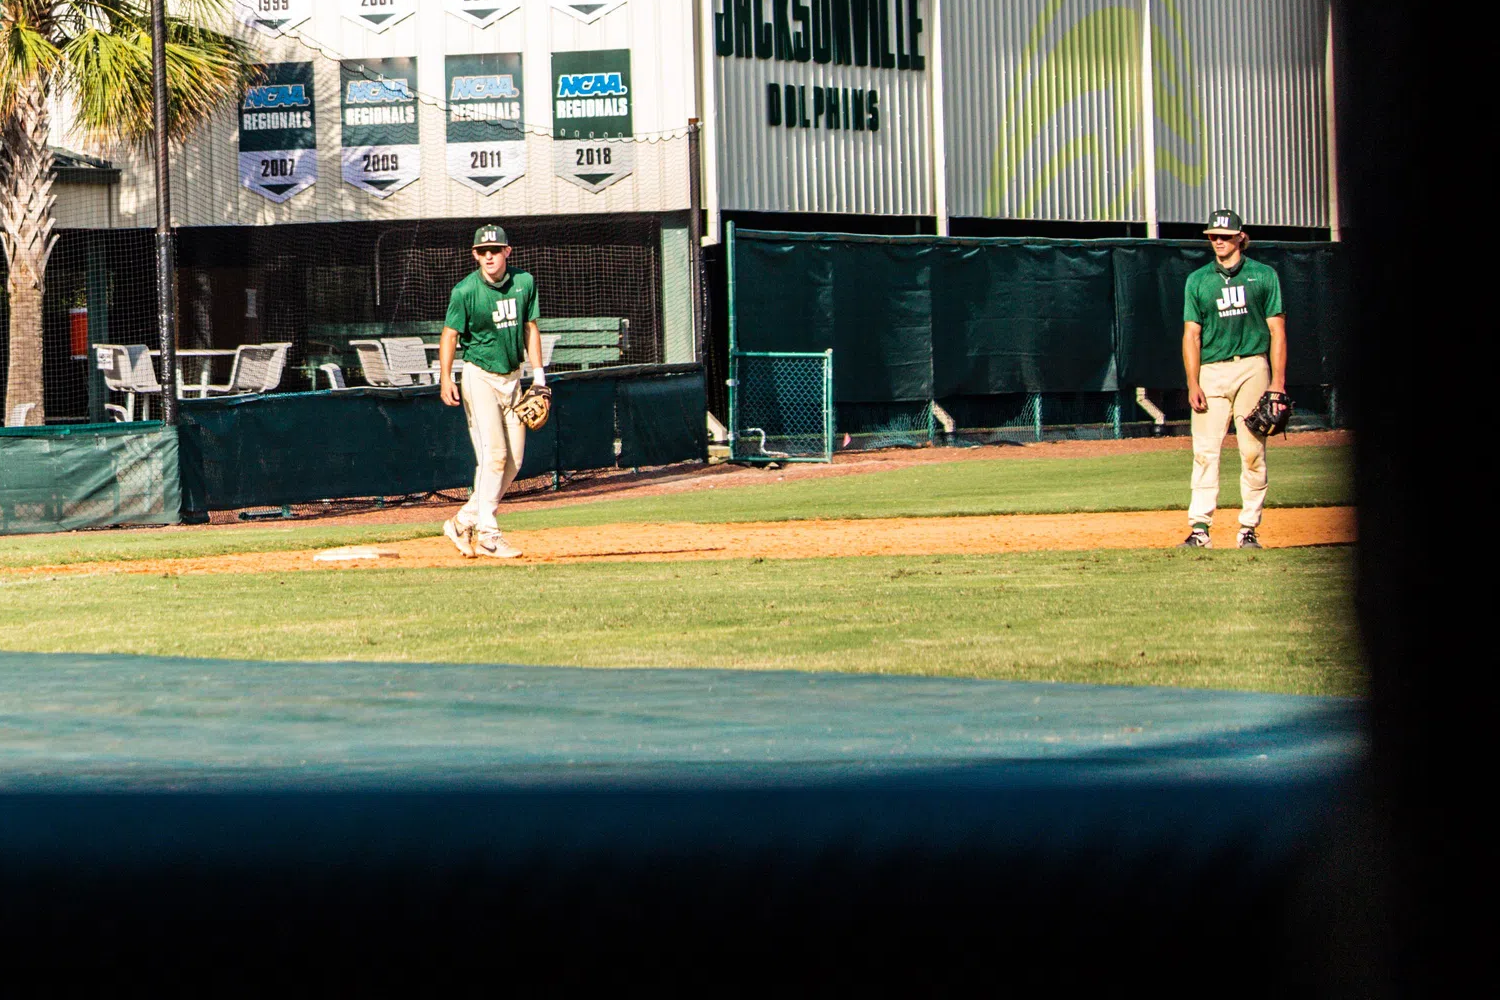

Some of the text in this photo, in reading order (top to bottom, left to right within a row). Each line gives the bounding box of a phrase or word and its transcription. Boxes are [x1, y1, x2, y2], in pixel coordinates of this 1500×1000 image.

[345, 106, 415, 126] REGIONALS
[451, 102, 520, 122] REGIONALS
[556, 97, 628, 118] REGIONALS
[768, 82, 879, 132] DOLPHINS
[243, 111, 312, 131] REGIONALS
[363, 154, 399, 172] 2009
[470, 150, 502, 169] 2011
[576, 148, 611, 165] 2018
[261, 158, 295, 177] 2007
[1213, 216, 1229, 228] JU
[481, 231, 497, 242] JU
[1216, 286, 1246, 310] JU
[492, 298, 517, 323] JU
